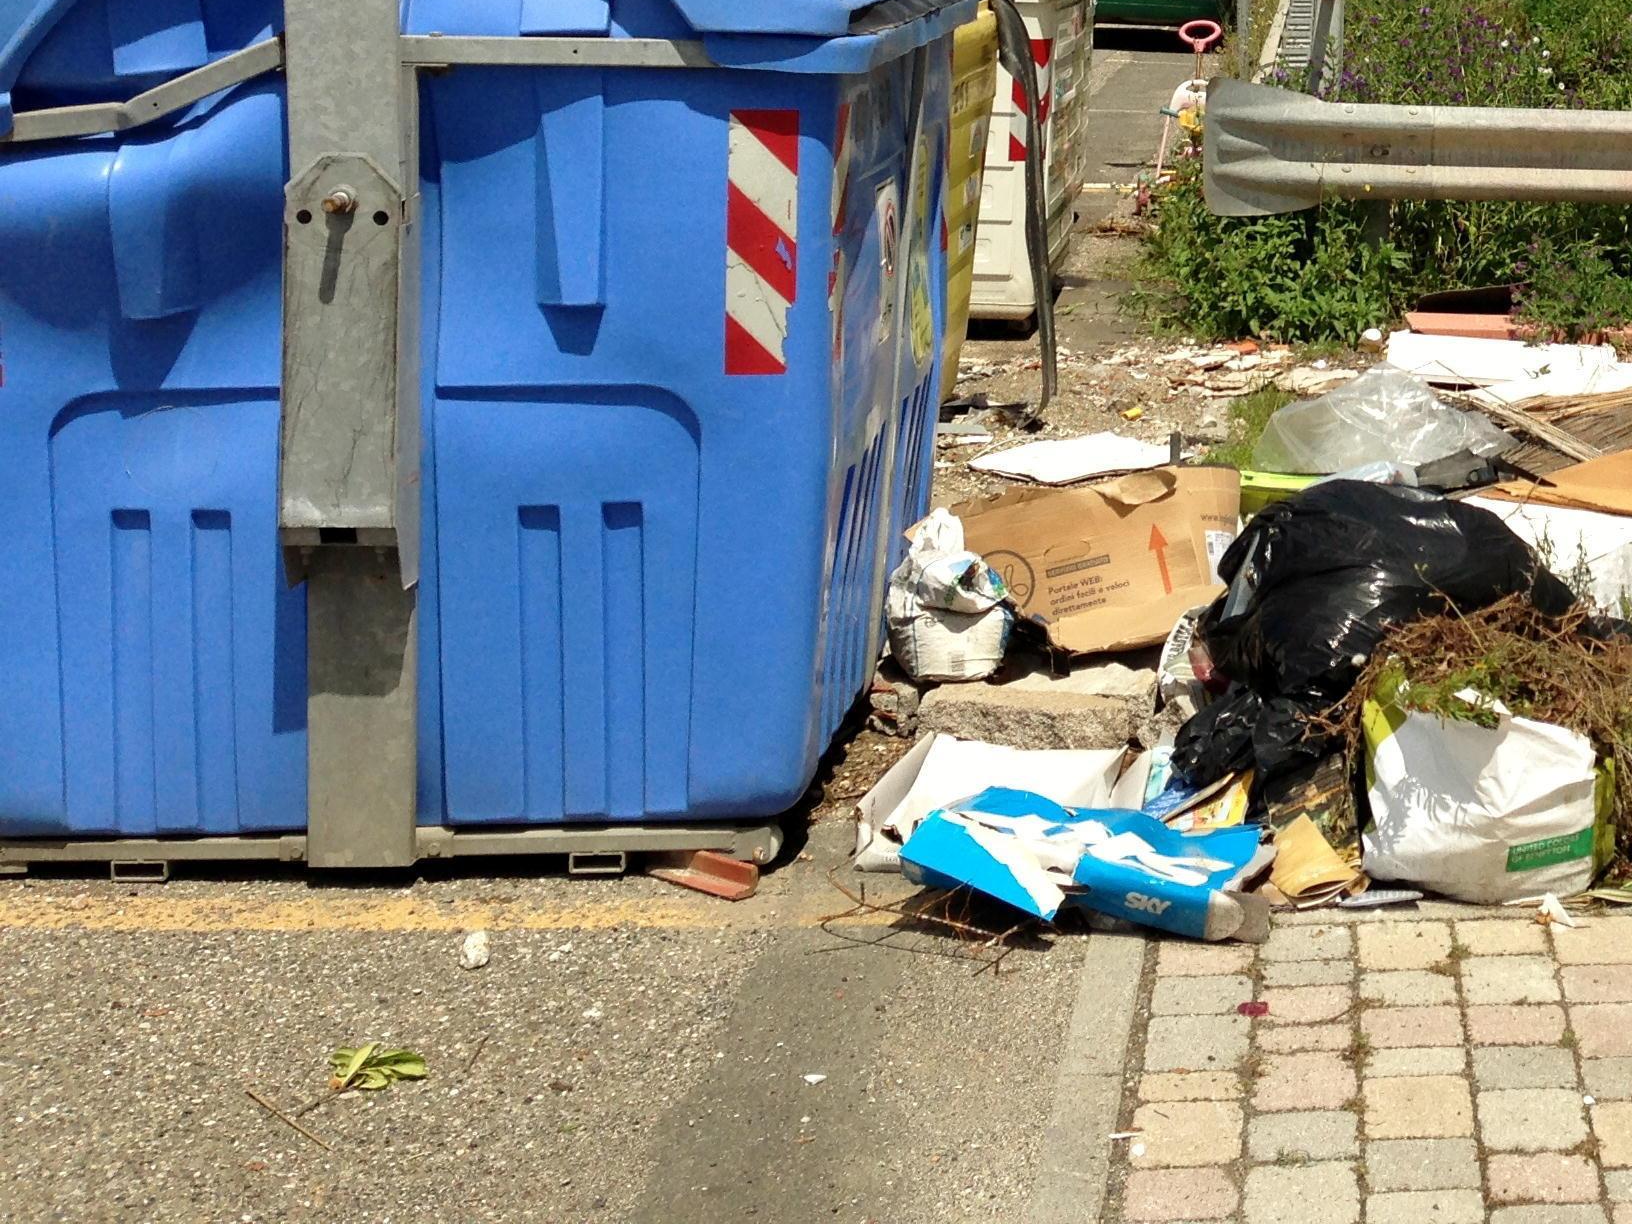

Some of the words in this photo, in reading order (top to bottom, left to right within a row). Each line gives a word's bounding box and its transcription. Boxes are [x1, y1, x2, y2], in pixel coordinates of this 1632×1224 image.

[1048, 582, 1079, 595] Portale
[1050, 593, 1075, 606] ordini
[1077, 587, 1096, 599] facili
[1105, 579, 1130, 592] veloci
[1052, 597, 1107, 616] direttamente
[1124, 891, 1172, 915] SKY
